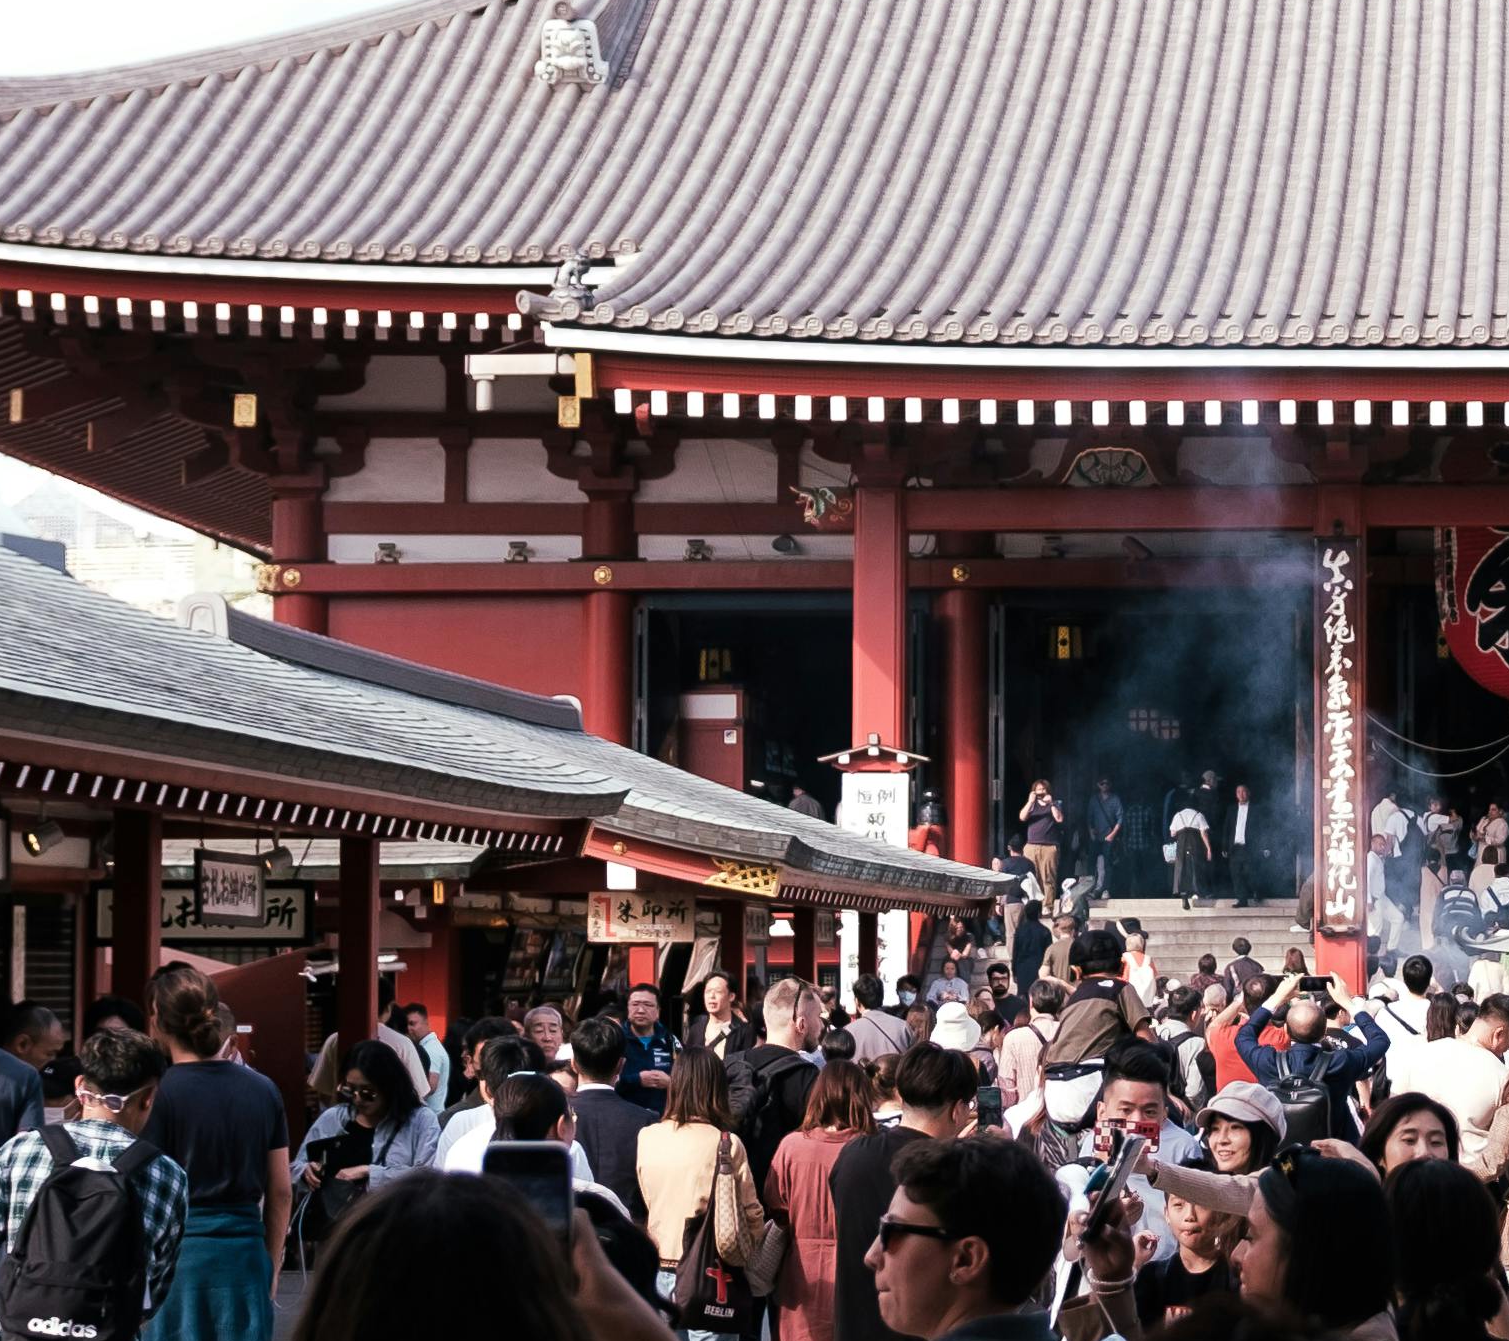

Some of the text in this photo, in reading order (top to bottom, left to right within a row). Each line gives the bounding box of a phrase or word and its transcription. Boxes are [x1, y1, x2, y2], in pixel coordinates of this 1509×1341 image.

[617, 899, 688, 924] 朱印所
[704, 1304, 735, 1318] BERLIN
[27, 1316, 98, 1339] adidas
